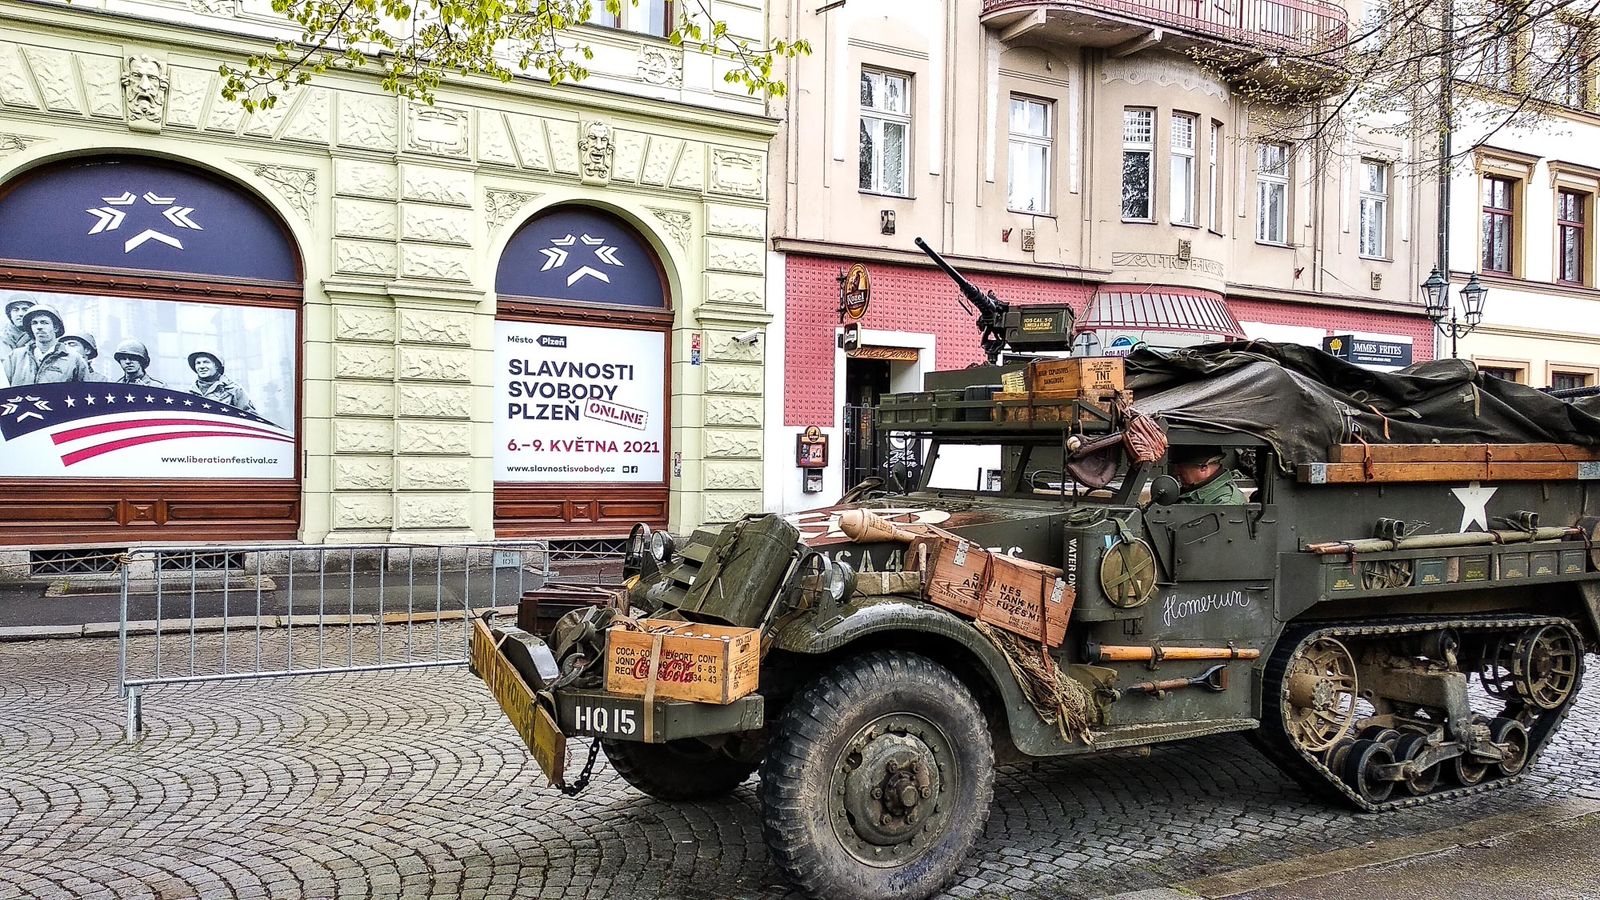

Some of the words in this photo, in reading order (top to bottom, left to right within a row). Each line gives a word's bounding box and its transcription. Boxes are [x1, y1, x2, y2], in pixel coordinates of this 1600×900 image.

[847, 292, 865, 305] Kozel
[507, 335, 534, 344] Město
[542, 336, 565, 346] Plzeň
[1379, 345, 1402, 355] FRITES
[508, 358, 634, 381] SLAVNOSTI
[1094, 371, 1110, 381] TNT
[508, 380, 618, 401] SVOBODY
[508, 400, 580, 421] PLZEŇ
[589, 402, 644, 425] ONLINE
[550, 437, 619, 453] KVĚTNA
[623, 440, 660, 453] 2021
[161, 455, 278, 464] www.liberationfestival.cz
[507, 465, 616, 474] www.slavnostisvobody.cz
[1068, 538, 1077, 572] WATER
[1163, 591, 1250, 627] Homerun
[666, 651, 693, 662] EXPORT
[697, 655, 717, 664] CONT
[575, 705, 608, 733] HQ
[614, 708, 636, 735] 15
